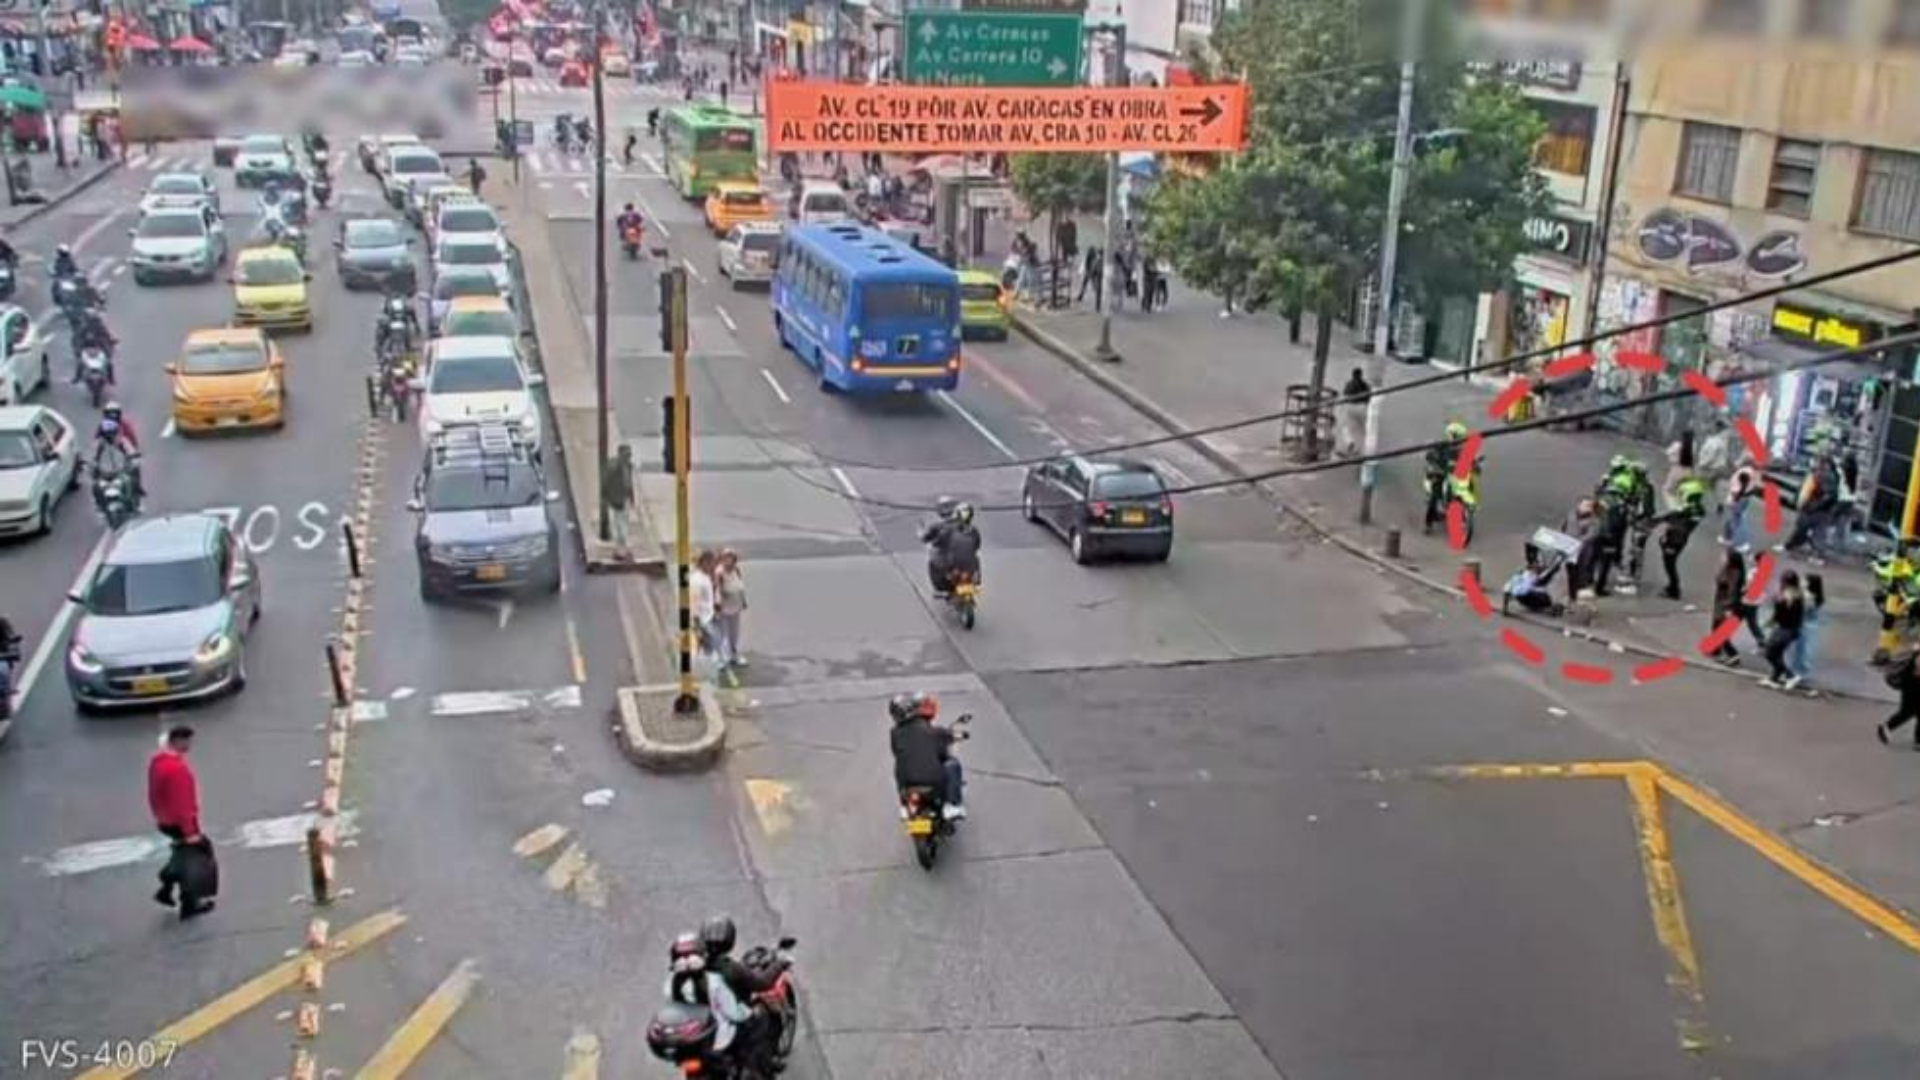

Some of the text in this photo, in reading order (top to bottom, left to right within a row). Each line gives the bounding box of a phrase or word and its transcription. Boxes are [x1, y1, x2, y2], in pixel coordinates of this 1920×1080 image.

[946, 22, 1050, 41] Av Caracas
[916, 47, 1043, 64] Av Carrera 10
[818, 95, 848, 118] AV.
[855, 98, 880, 118] CL
[888, 98, 911, 118] 19
[963, 98, 991, 119] AV.
[997, 99, 1085, 120] CARACAS
[1091, 99, 1114, 119] EN
[1119, 99, 1167, 120] OBRA
[781, 121, 806, 142] AL
[813, 122, 929, 143] OCCIDENTE
[936, 123, 1003, 143] TOMAR
[1042, 123, 1080, 143] CRA
[1086, 124, 1107, 143] 10
[1122, 123, 1148, 142] AV.
[1153, 123, 1172, 142] CL
[1177, 124, 1198, 143] 26
